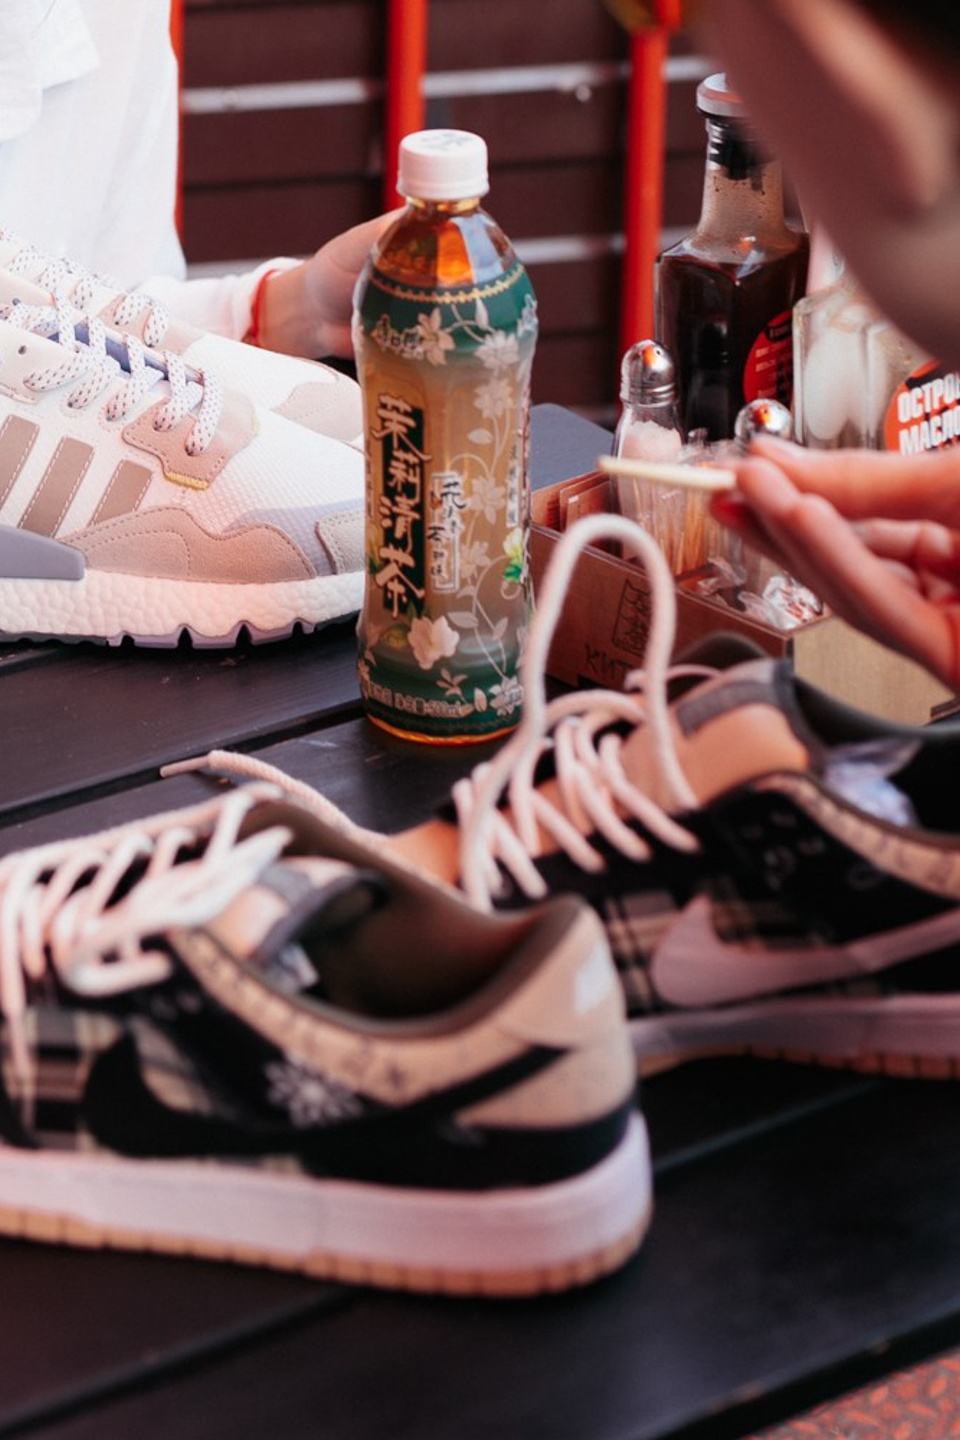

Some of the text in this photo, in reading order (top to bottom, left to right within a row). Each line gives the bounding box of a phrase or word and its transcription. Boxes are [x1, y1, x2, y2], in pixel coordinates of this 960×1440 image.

[897, 372, 960, 424] ОСТРО
[371, 393, 433, 619] 茉莉清茶
